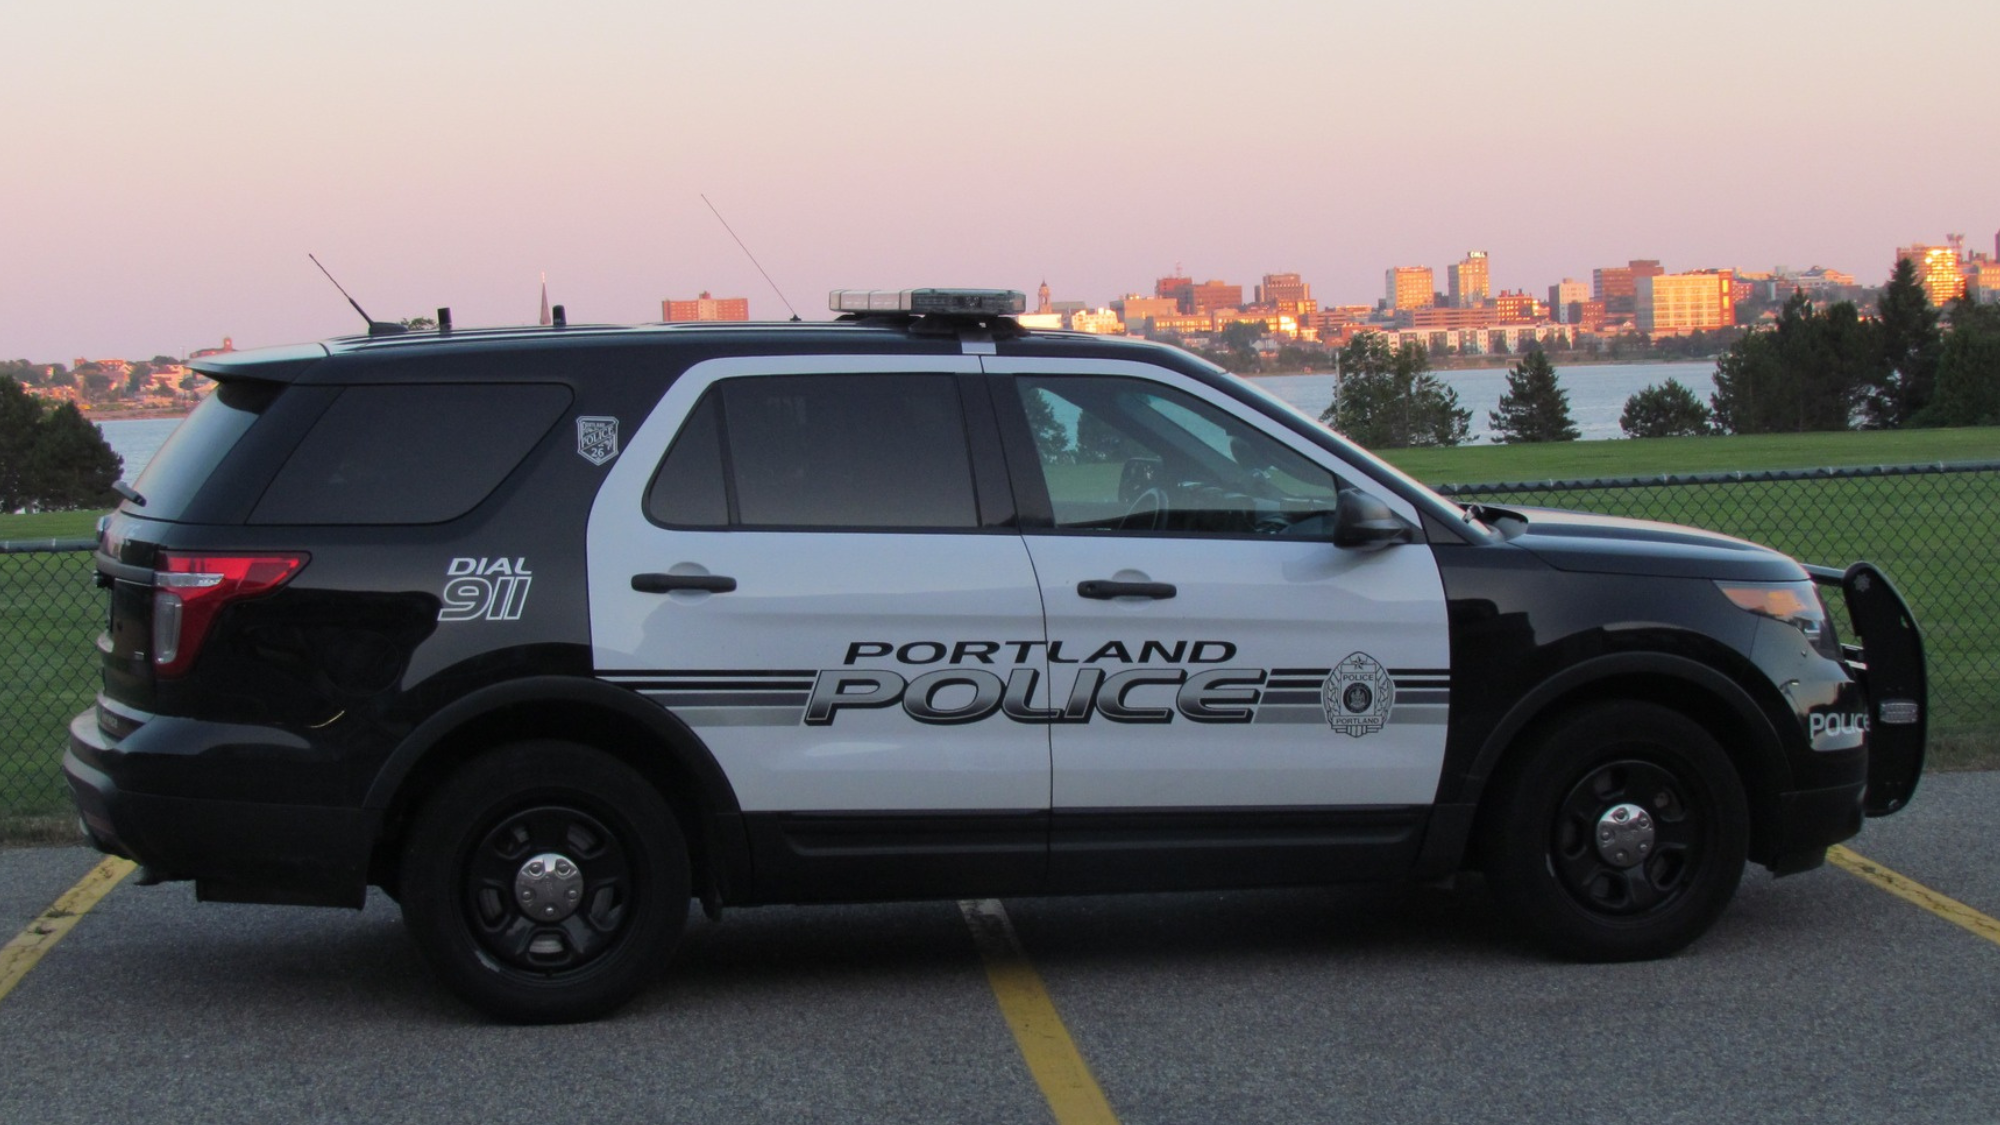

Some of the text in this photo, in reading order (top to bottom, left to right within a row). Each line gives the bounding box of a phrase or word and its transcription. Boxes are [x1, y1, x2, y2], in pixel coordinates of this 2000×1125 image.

[582, 426, 614, 448] POLICE
[591, 448, 605, 458] 26
[446, 557, 533, 576] DIAL
[437, 576, 533, 621] 911
[843, 640, 1238, 665] PORTLAND
[804, 668, 1268, 726] POLICE
[1336, 717, 1380, 725] PORTLAND
